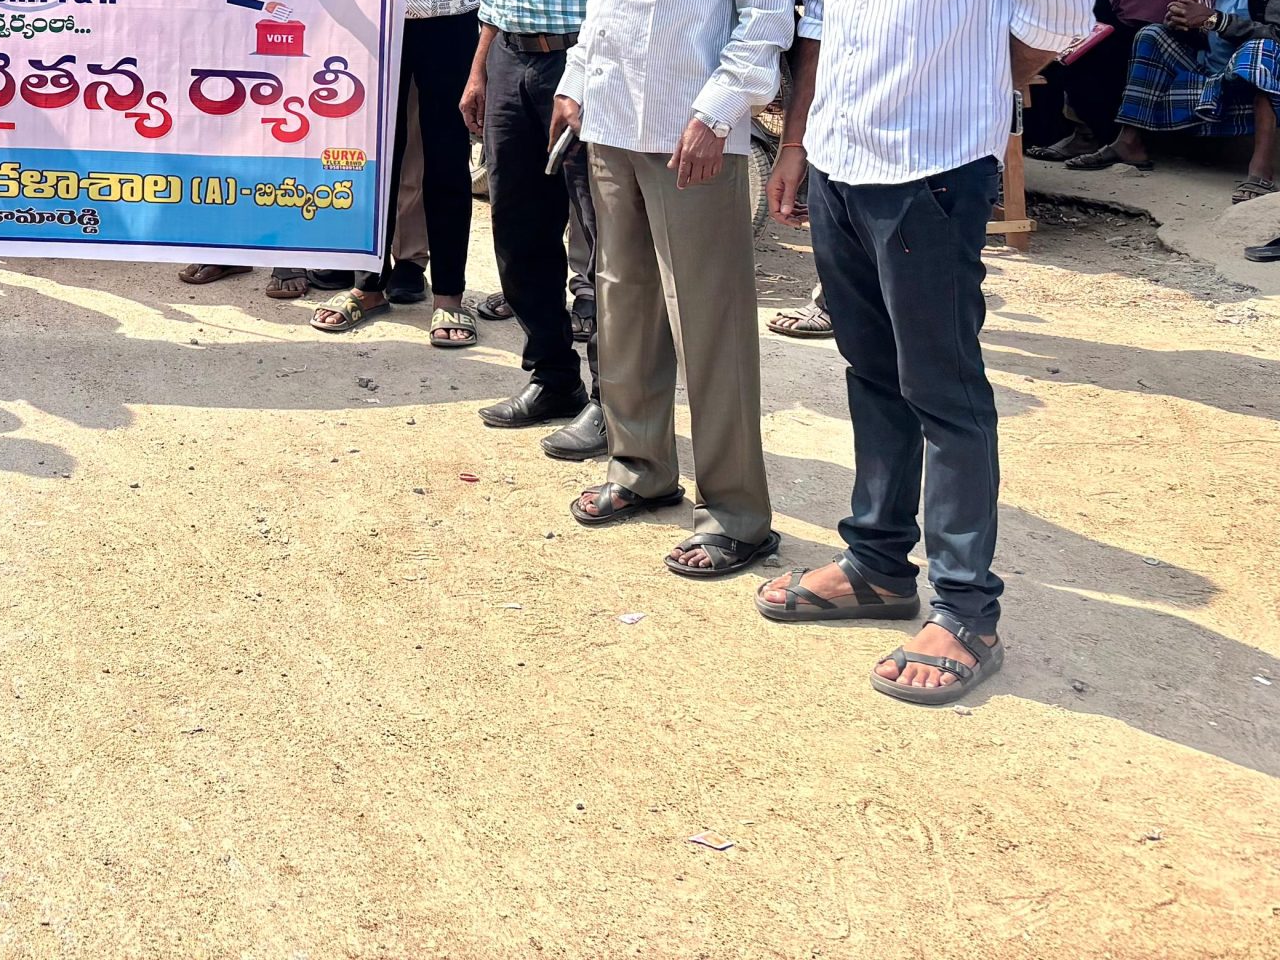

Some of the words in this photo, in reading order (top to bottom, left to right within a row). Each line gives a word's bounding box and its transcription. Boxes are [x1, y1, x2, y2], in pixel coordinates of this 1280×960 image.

[266, 34, 294, 44] VOTE
[189, 55, 366, 143] ర్యాలీ
[323, 149, 364, 161] SURYA
